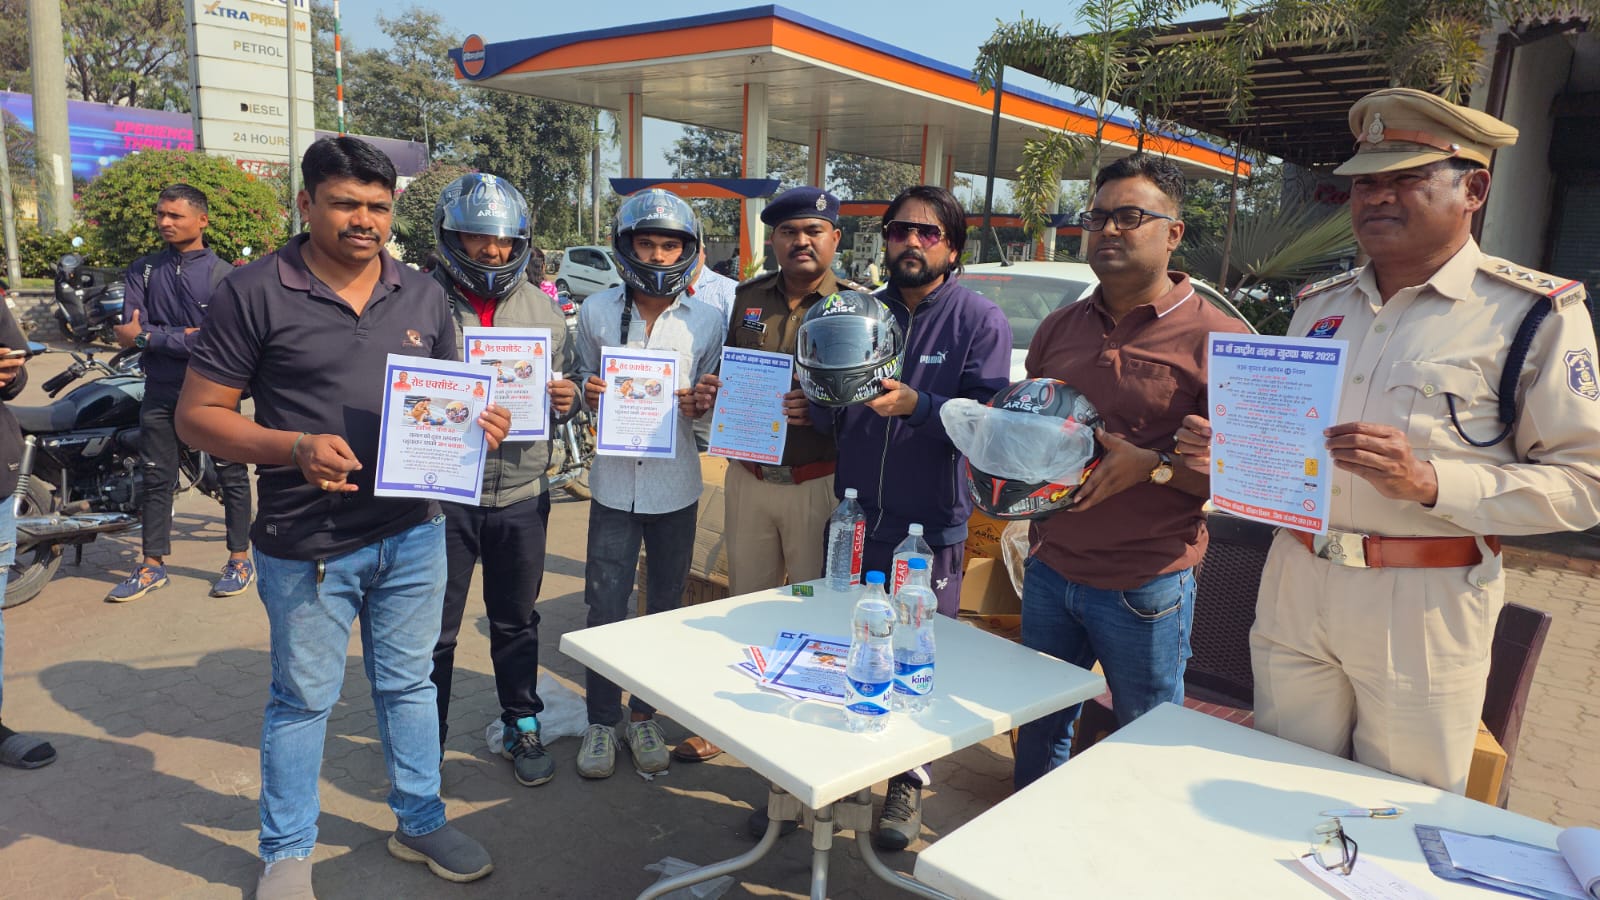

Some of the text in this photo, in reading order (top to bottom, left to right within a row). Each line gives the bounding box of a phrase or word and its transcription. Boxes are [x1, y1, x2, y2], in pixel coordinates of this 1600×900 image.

[233, 41, 283, 57] PETROL
[240, 103, 283, 116] DIESEL
[233, 132, 247, 142] 24
[823, 305, 856, 316] ARISE
[1314, 351, 1336, 361] 2025
[1003, 401, 1042, 414] ARISE
[854, 524, 864, 551] CLEAR
